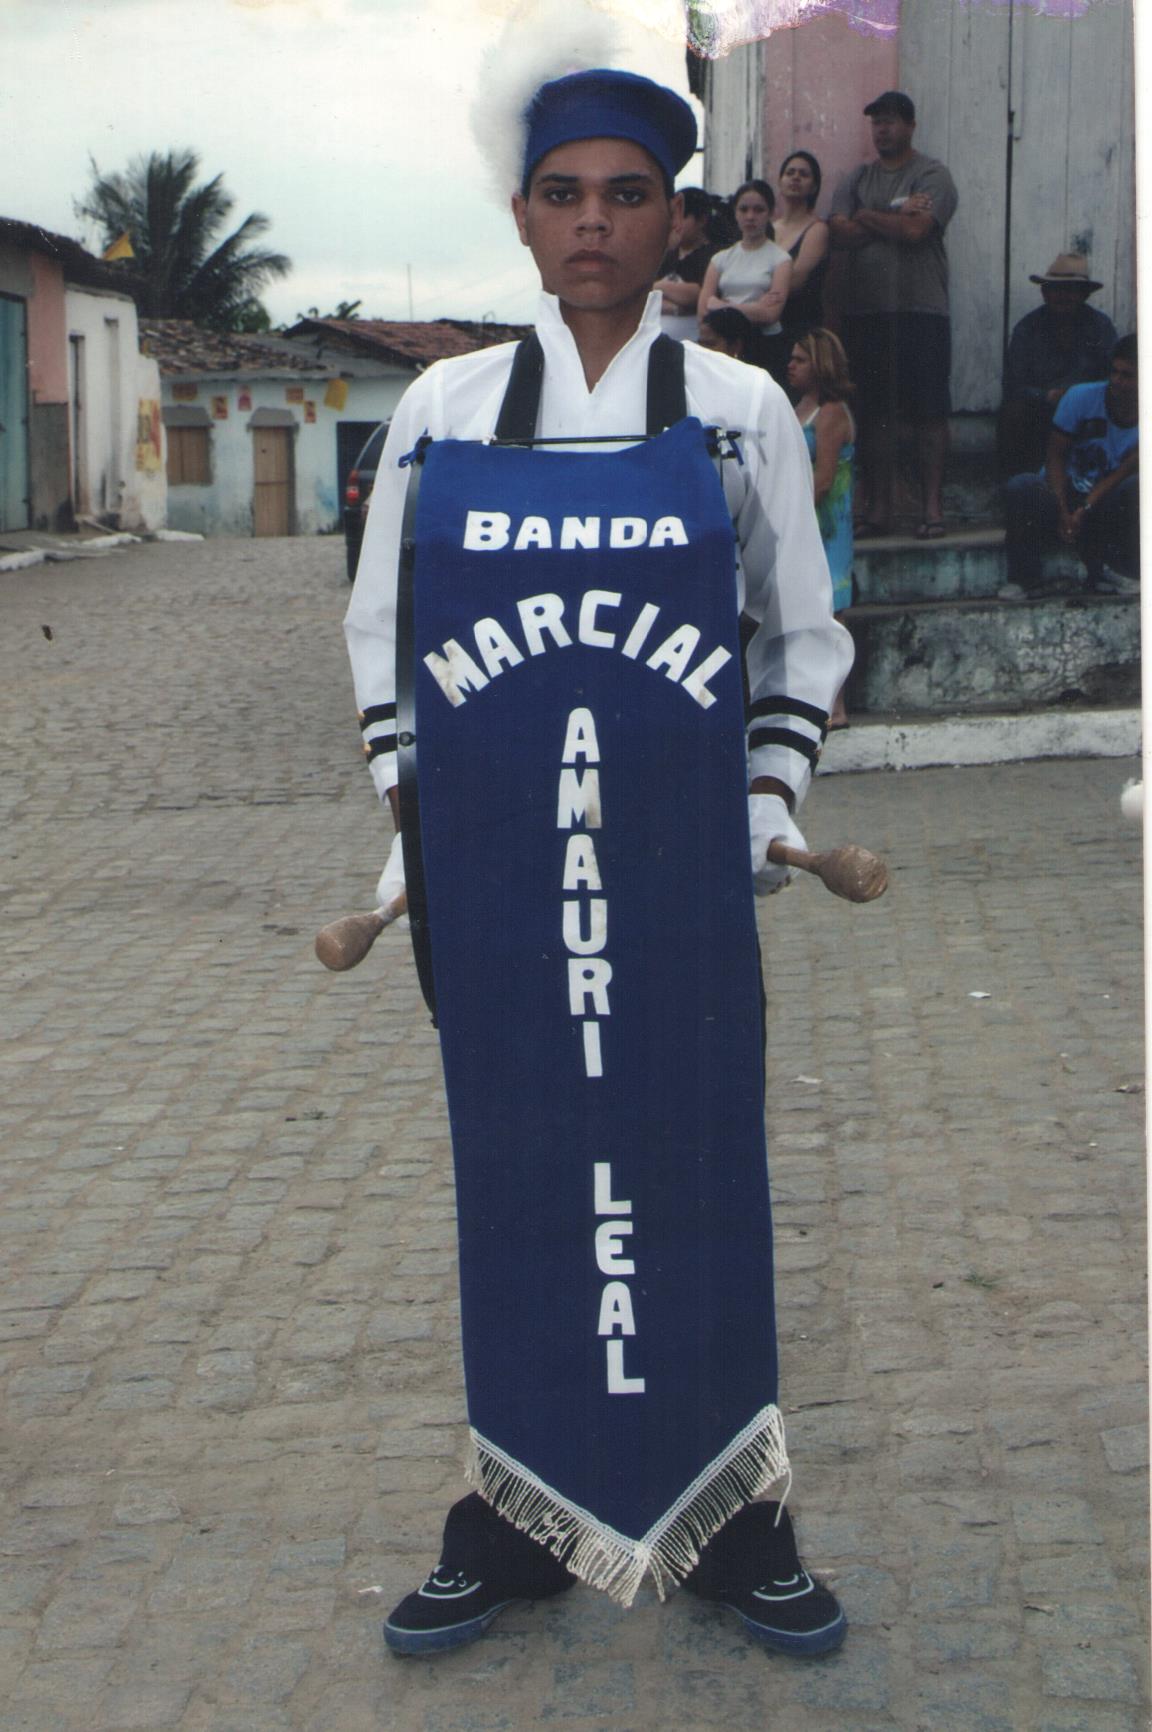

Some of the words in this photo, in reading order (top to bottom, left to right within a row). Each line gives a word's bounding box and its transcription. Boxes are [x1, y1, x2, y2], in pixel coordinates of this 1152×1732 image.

[463, 510, 689, 551] BANDA
[423, 589, 733, 710] MARCIAL
[557, 707, 613, 1078] AMAURI
[594, 1162, 646, 1394] LEAL
